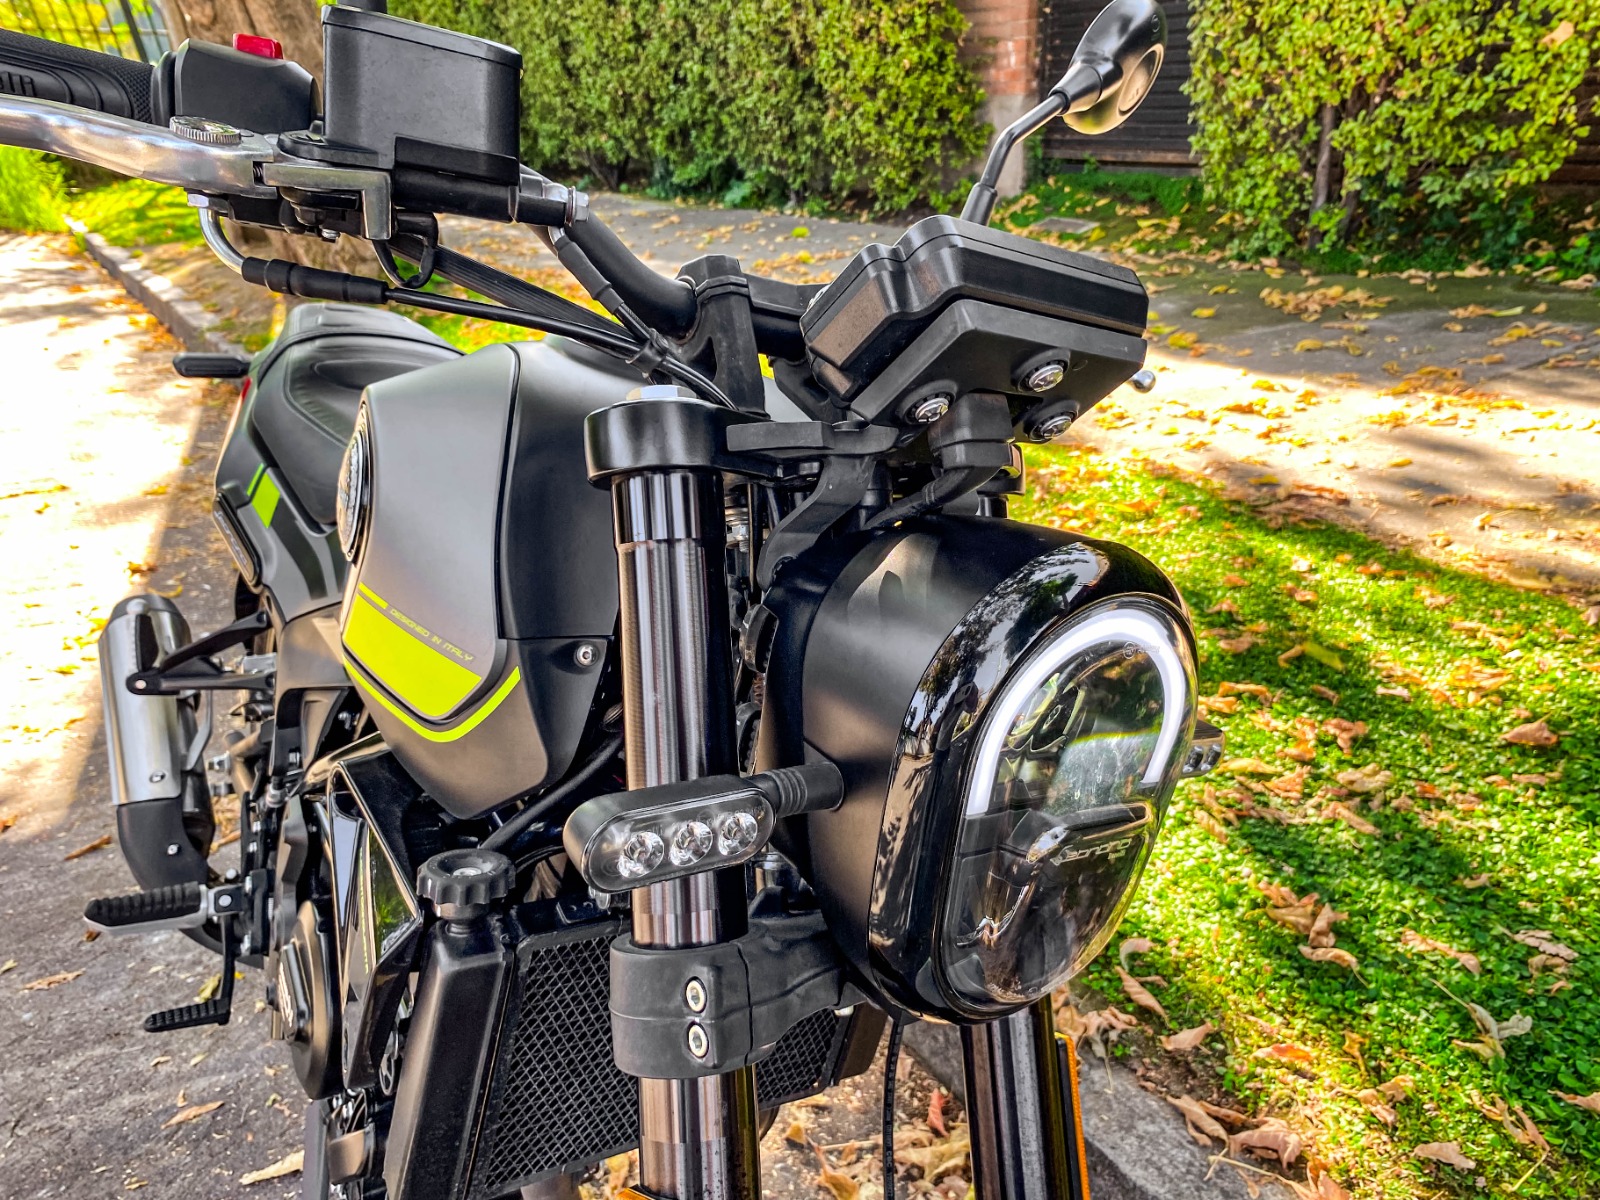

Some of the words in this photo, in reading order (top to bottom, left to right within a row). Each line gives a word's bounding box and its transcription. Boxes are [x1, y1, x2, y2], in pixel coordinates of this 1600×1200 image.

[389, 608, 430, 637] DESIGNED
[431, 635, 442, 645] IN
[442, 642, 474, 661] ITALY
